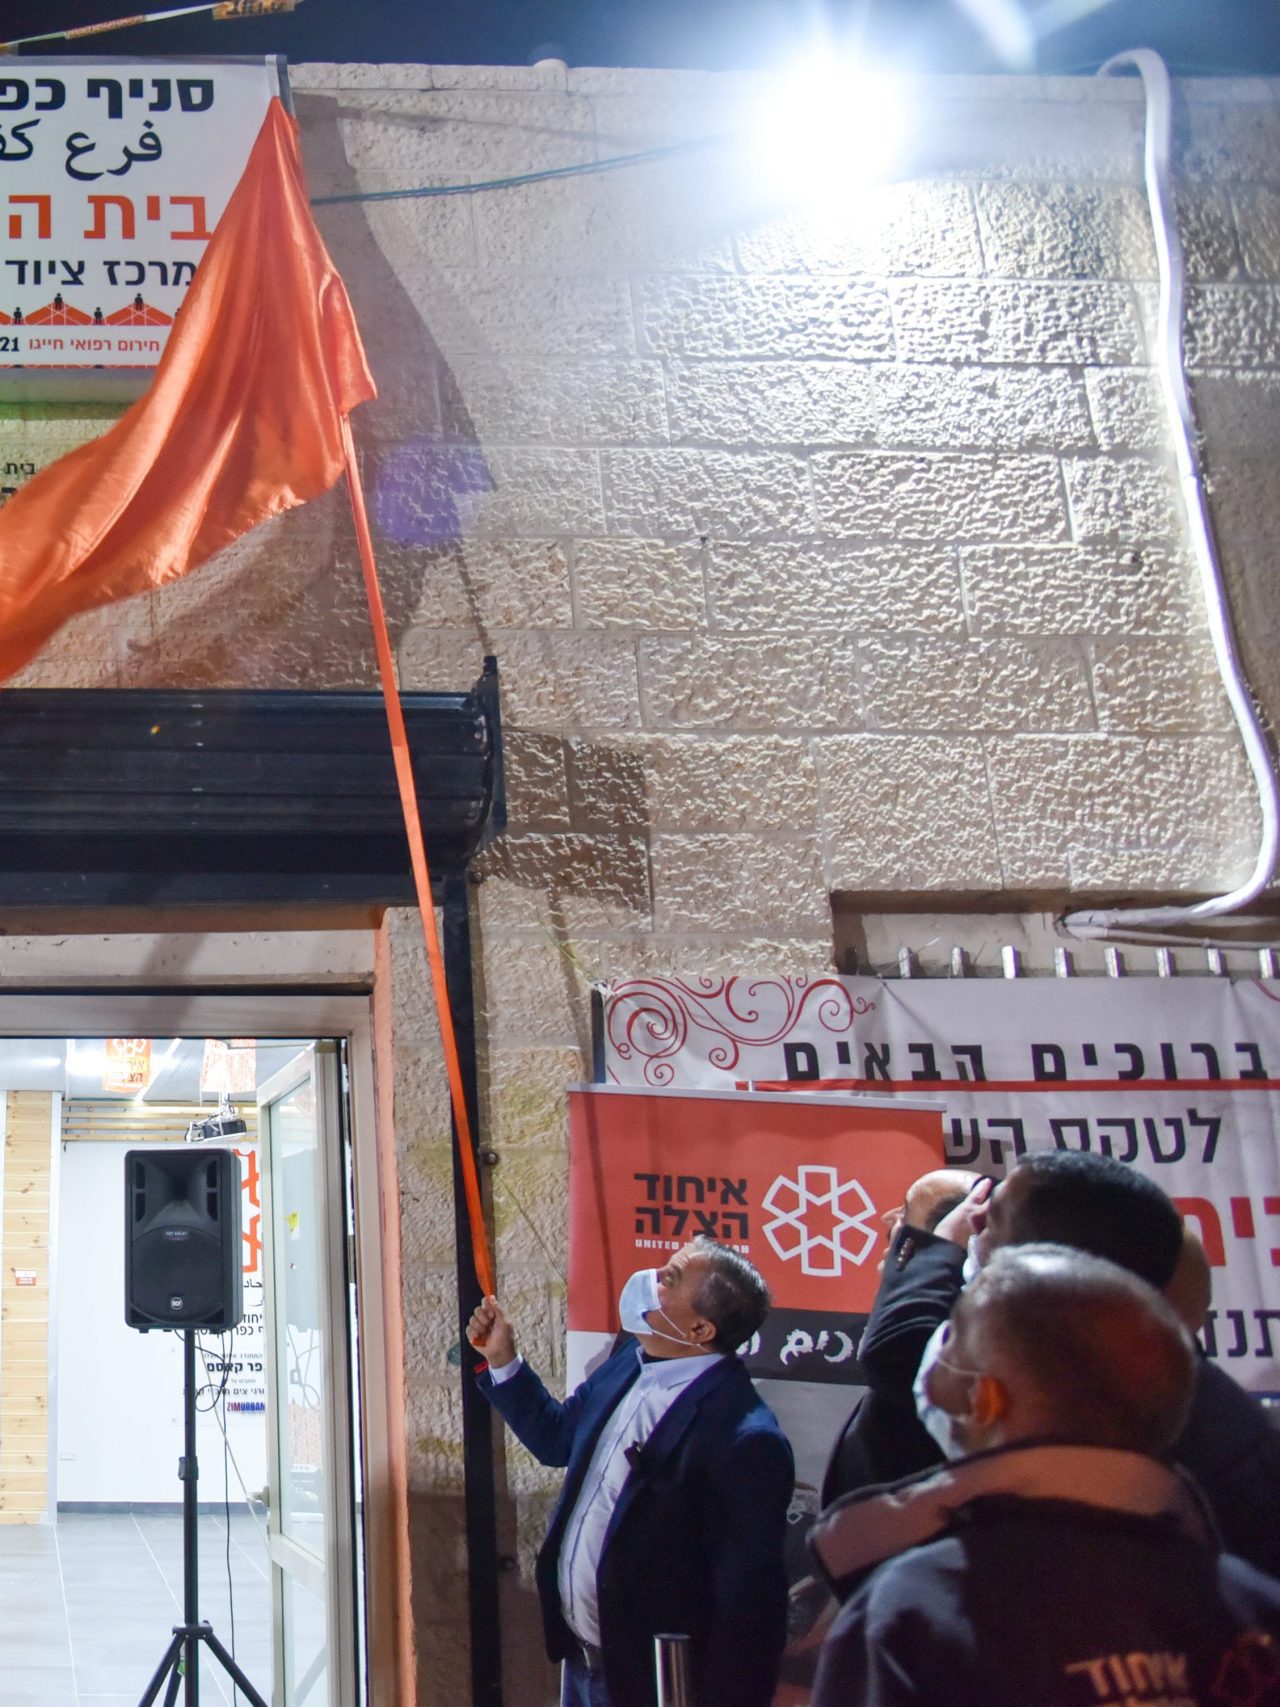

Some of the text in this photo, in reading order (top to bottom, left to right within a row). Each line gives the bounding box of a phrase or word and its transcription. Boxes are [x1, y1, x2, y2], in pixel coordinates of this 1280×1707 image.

[86, 78, 215, 119] סניף
[64, 119, 163, 181] فرع
[83, 194, 214, 240] בית
[4, 259, 86, 286] ציוד
[102, 259, 198, 287] מרכז
[28, 338, 64, 350] חייגו
[70, 339, 112, 351] רפואי
[117, 338, 160, 352] חירום
[2, 462, 37, 475] בית
[782, 1041, 1269, 1083] ברוכים הבאים
[1048, 1107, 1222, 1165] לטקס
[633, 1173, 749, 1206] איחוד
[635, 1204, 749, 1239] הצלה
[635, 1238, 680, 1250] UNITED
